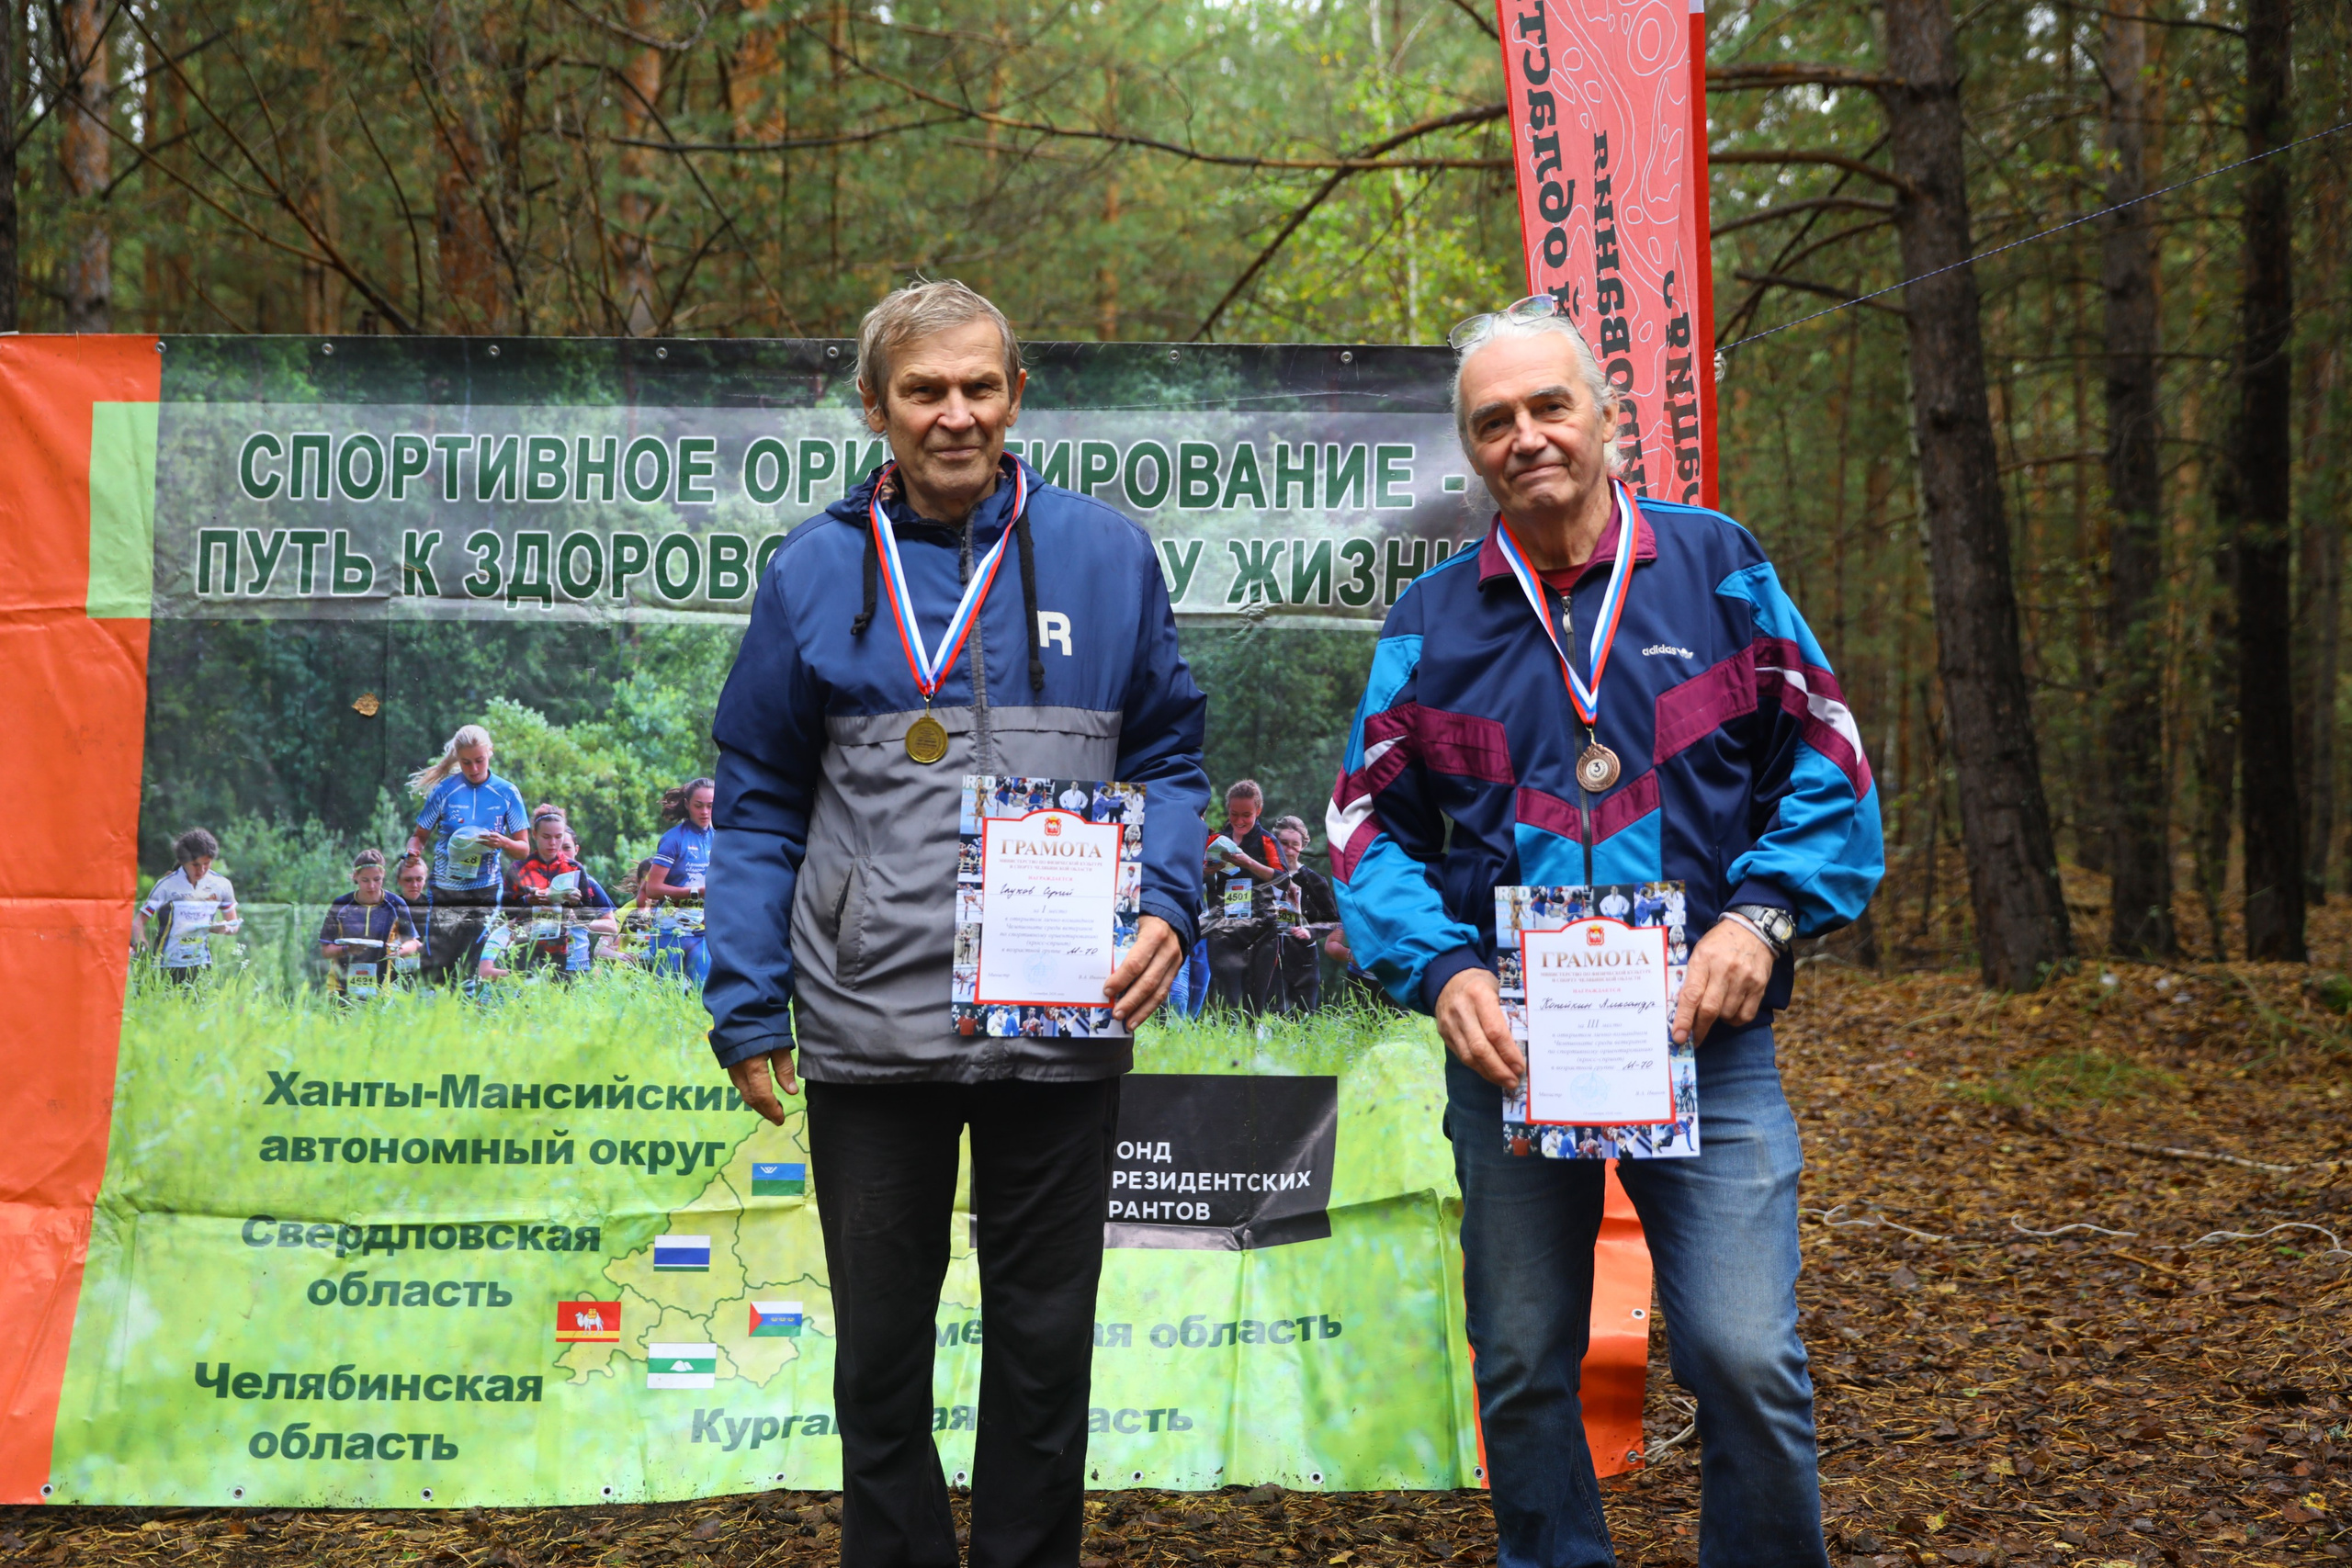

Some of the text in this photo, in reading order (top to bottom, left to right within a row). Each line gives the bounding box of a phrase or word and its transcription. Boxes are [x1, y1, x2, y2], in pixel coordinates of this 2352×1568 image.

[241, 433, 716, 503] СПОРТИВНОЕ
[744, 437, 1415, 509] ОРИИРОВАНИЕ
[197, 528, 374, 597] ПУТЬ
[403, 530, 442, 597] К
[1227, 538, 1476, 606] ЖИЗН
[1642, 644, 1678, 657] adidas
[1001, 839, 1102, 858] ГРАМОТА
[1227, 892, 1249, 902] 4501
[1540, 950, 1650, 968] ГРАМОТА
[259, 1129, 726, 1176] автономный округ
[1115, 1141, 1172, 1164] ОНД
[1112, 1169, 1312, 1193] РЕЗИДЕНТСКИХ
[1107, 1201, 1211, 1221] РАНТОВ
[241, 1214, 601, 1258] Свердловская
[307, 1271, 513, 1308] область
[1148, 1314, 1343, 1349] область
[195, 1361, 544, 1403] Челябинская
[248, 1422, 458, 1461] область
